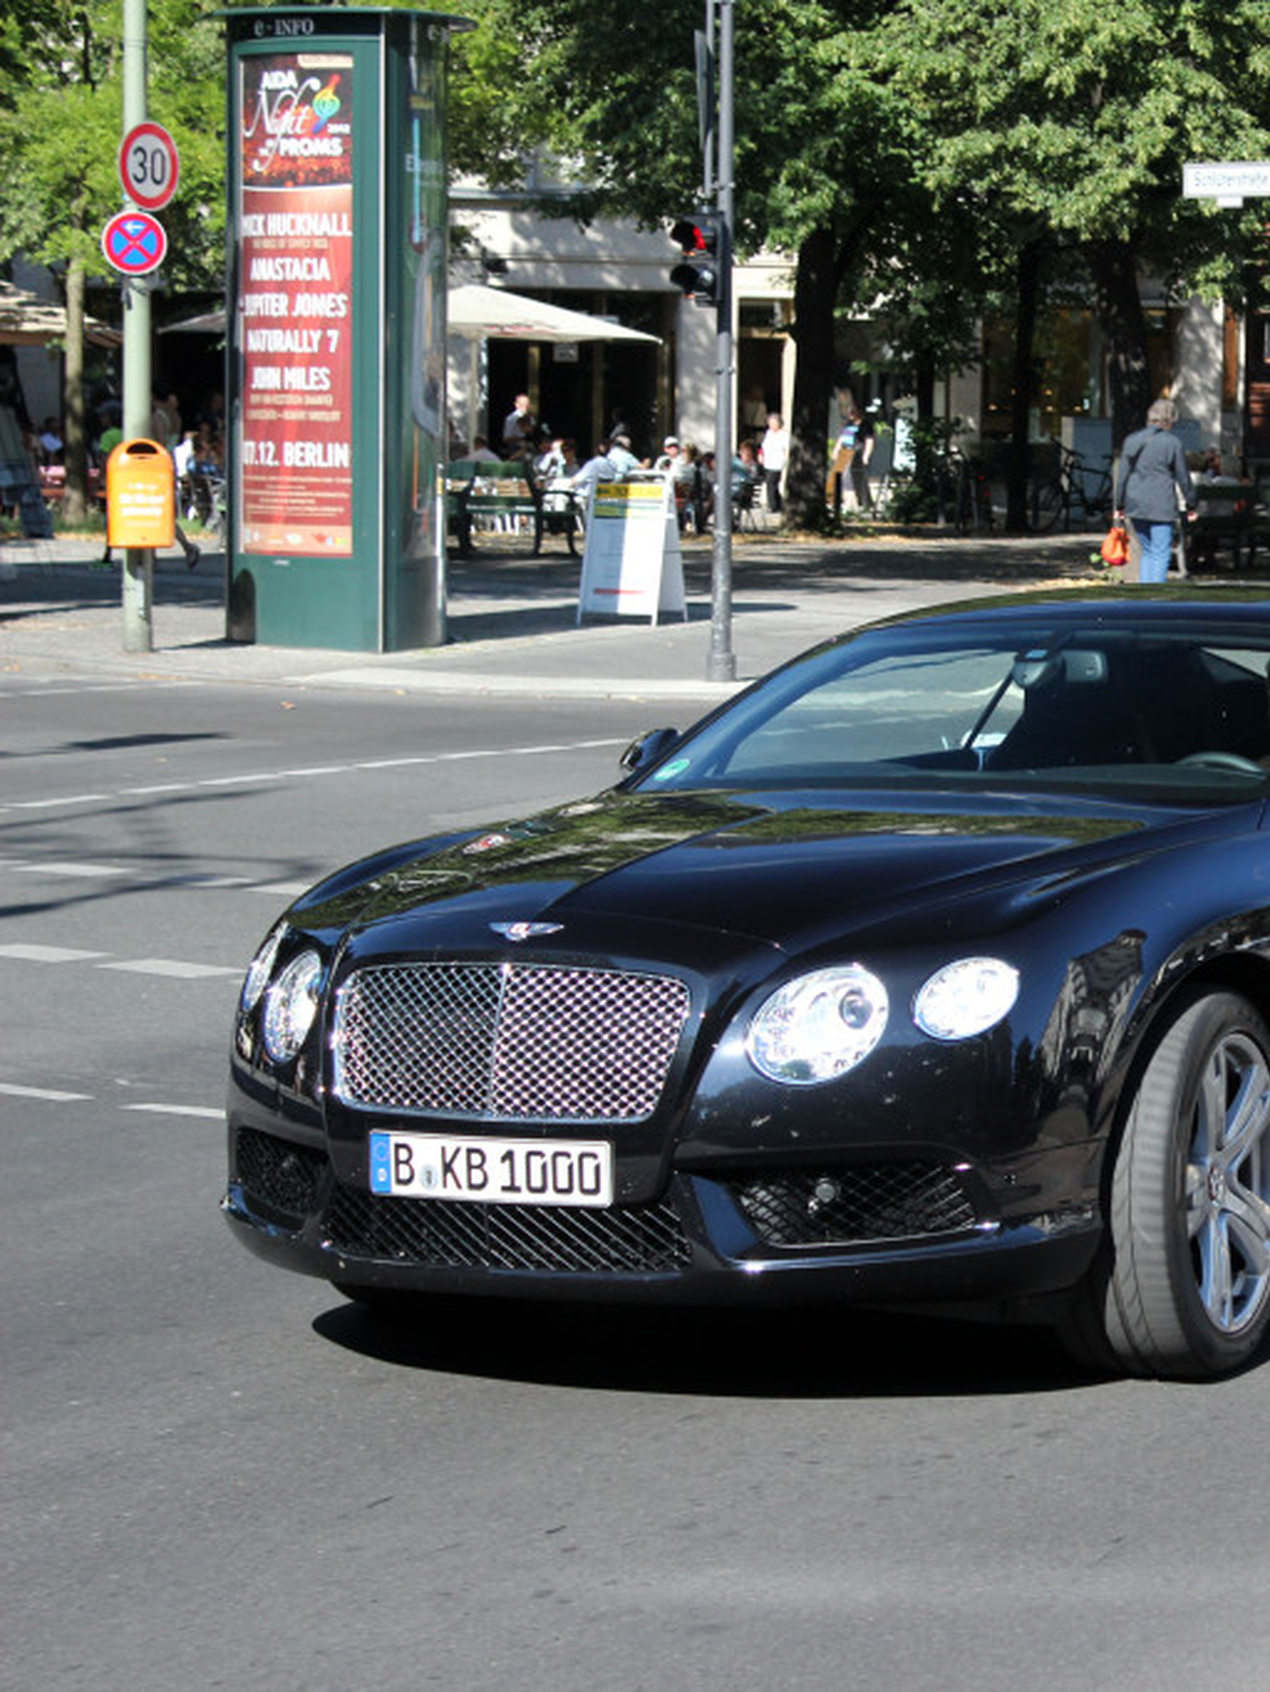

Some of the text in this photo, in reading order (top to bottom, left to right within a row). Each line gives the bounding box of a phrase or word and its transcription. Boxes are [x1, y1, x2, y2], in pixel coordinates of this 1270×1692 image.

[280, 136, 343, 157] PROMS
[132, 146, 166, 186] 30
[267, 212, 353, 236] HUCKNALL
[250, 256, 331, 281] ANASTACIA
[291, 292, 348, 318] JONES
[326, 329, 340, 353] 7
[283, 366, 331, 391] MILES
[283, 441, 350, 468] BERLIN
[393, 1143, 602, 1196] B KB 1000
